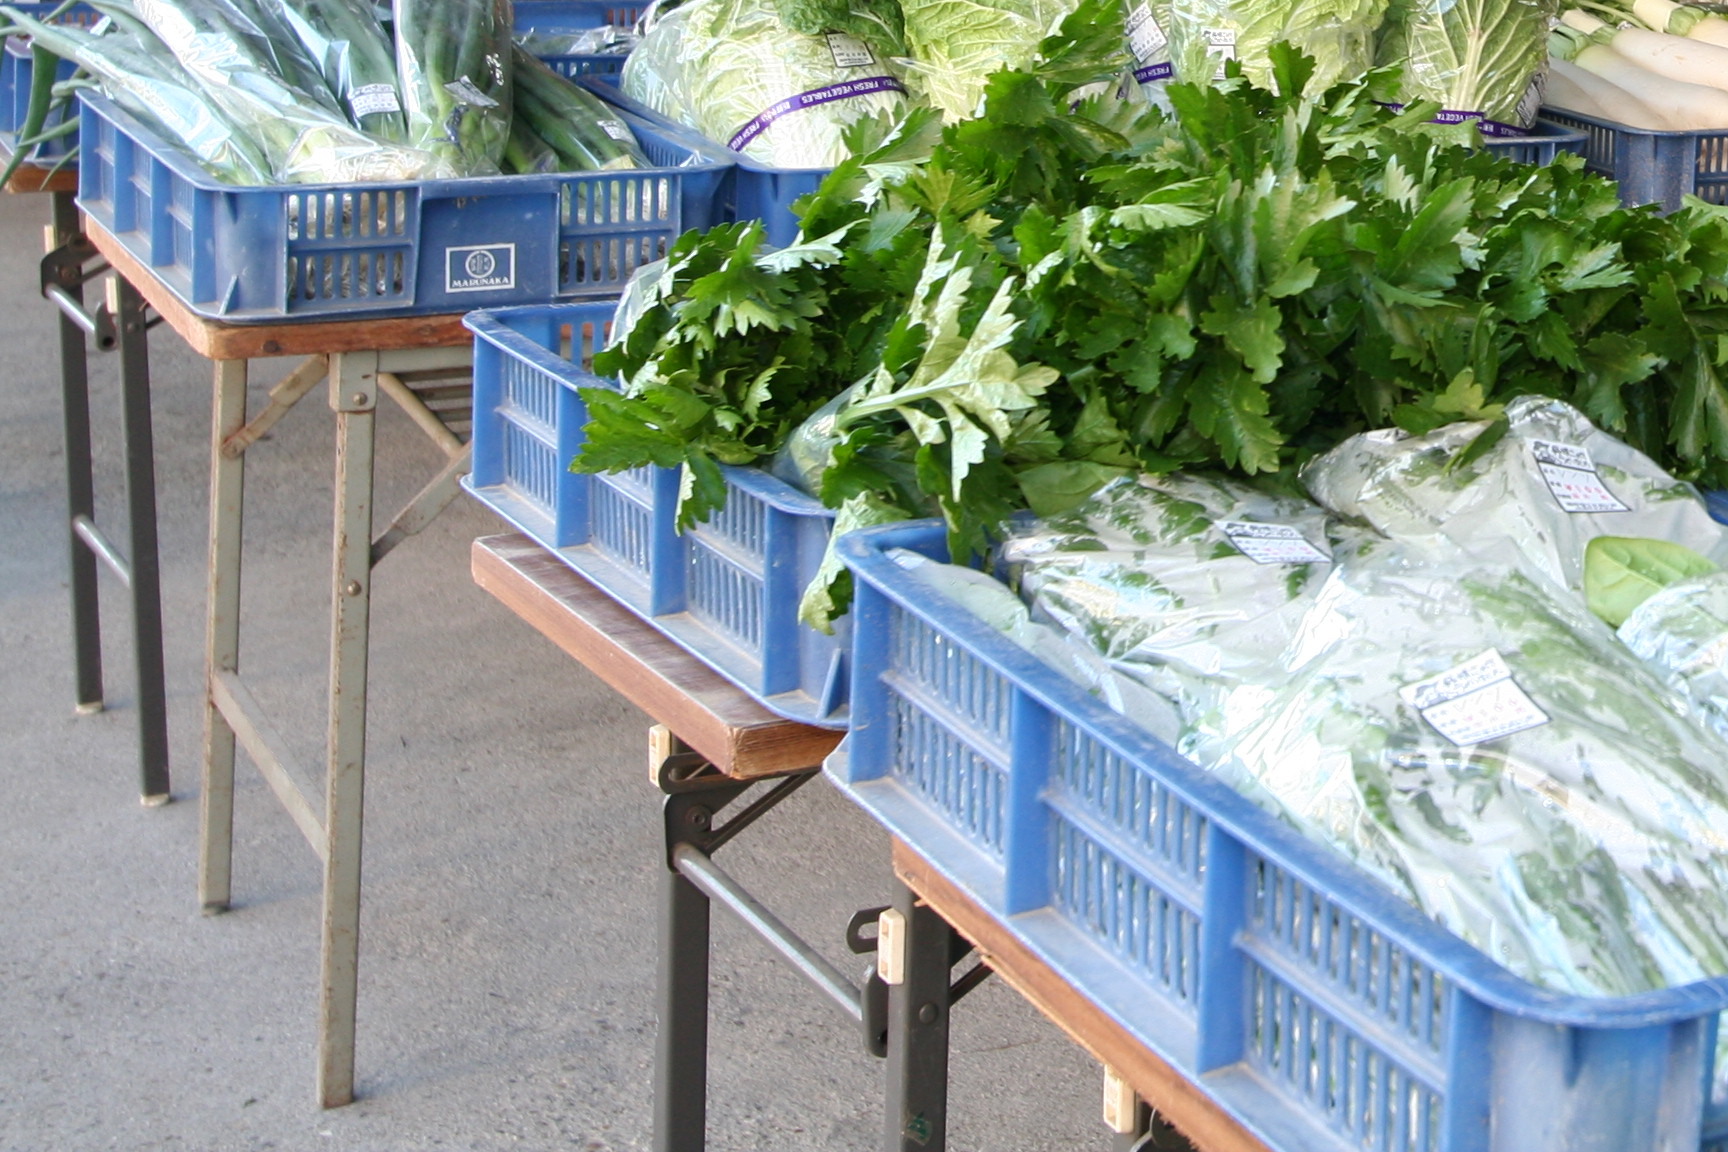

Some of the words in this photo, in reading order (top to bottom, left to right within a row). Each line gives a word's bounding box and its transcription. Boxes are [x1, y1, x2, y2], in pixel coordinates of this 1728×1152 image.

[853, 80, 879, 92] FRESH
[801, 85, 853, 104] VEGETABLES
[451, 276, 510, 288] MARUNAKA
